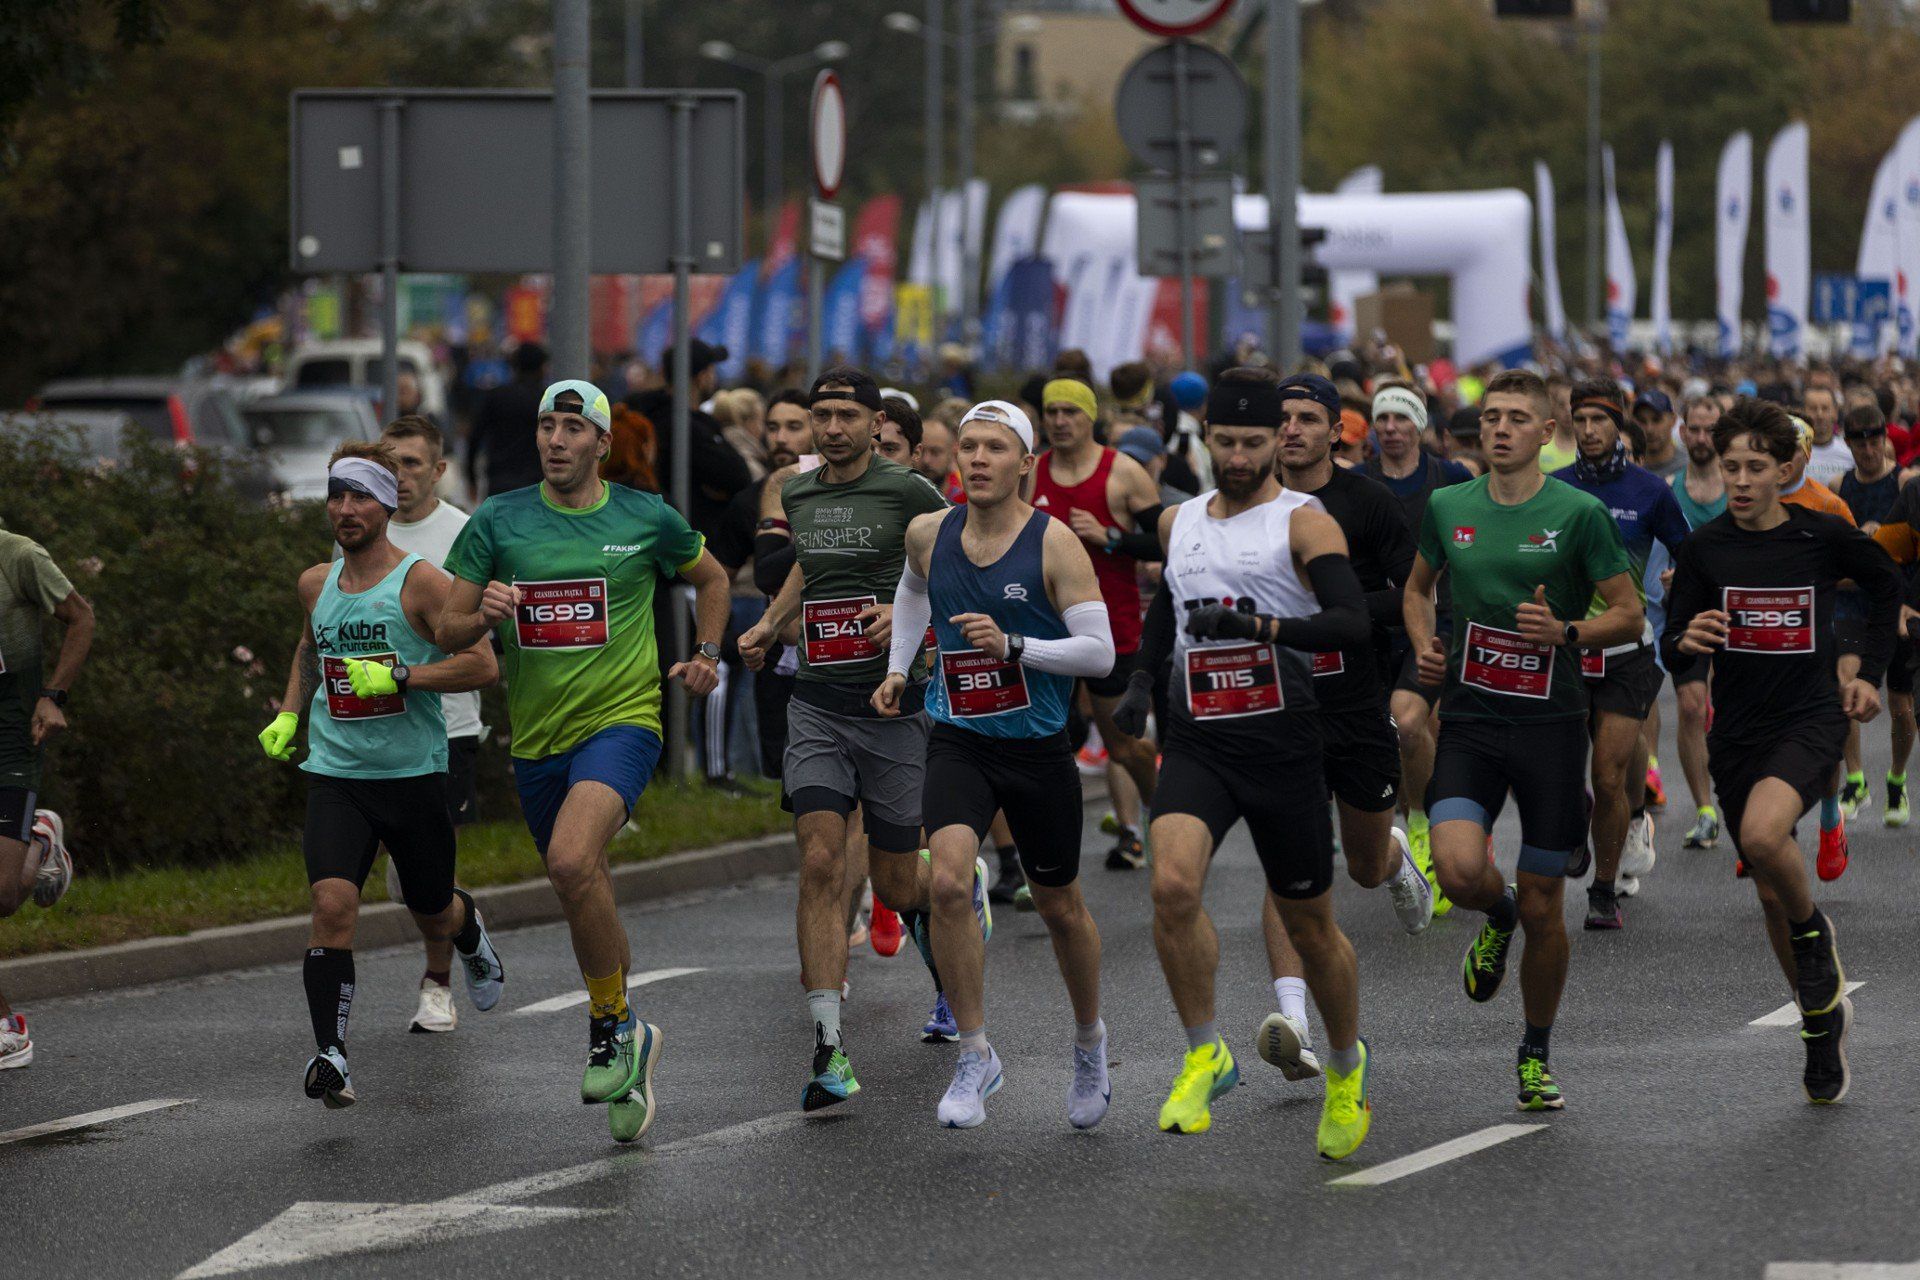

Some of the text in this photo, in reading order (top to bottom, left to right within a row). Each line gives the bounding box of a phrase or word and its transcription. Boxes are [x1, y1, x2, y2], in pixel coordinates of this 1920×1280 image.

[797, 527, 872, 548] FINISHER
[525, 603, 595, 623] 1699
[1736, 610, 1803, 627] 1296
[815, 620, 863, 639] 1341
[1476, 646, 1540, 671] 1788
[958, 671, 1002, 691] 381
[1207, 669, 1255, 690] 1115
